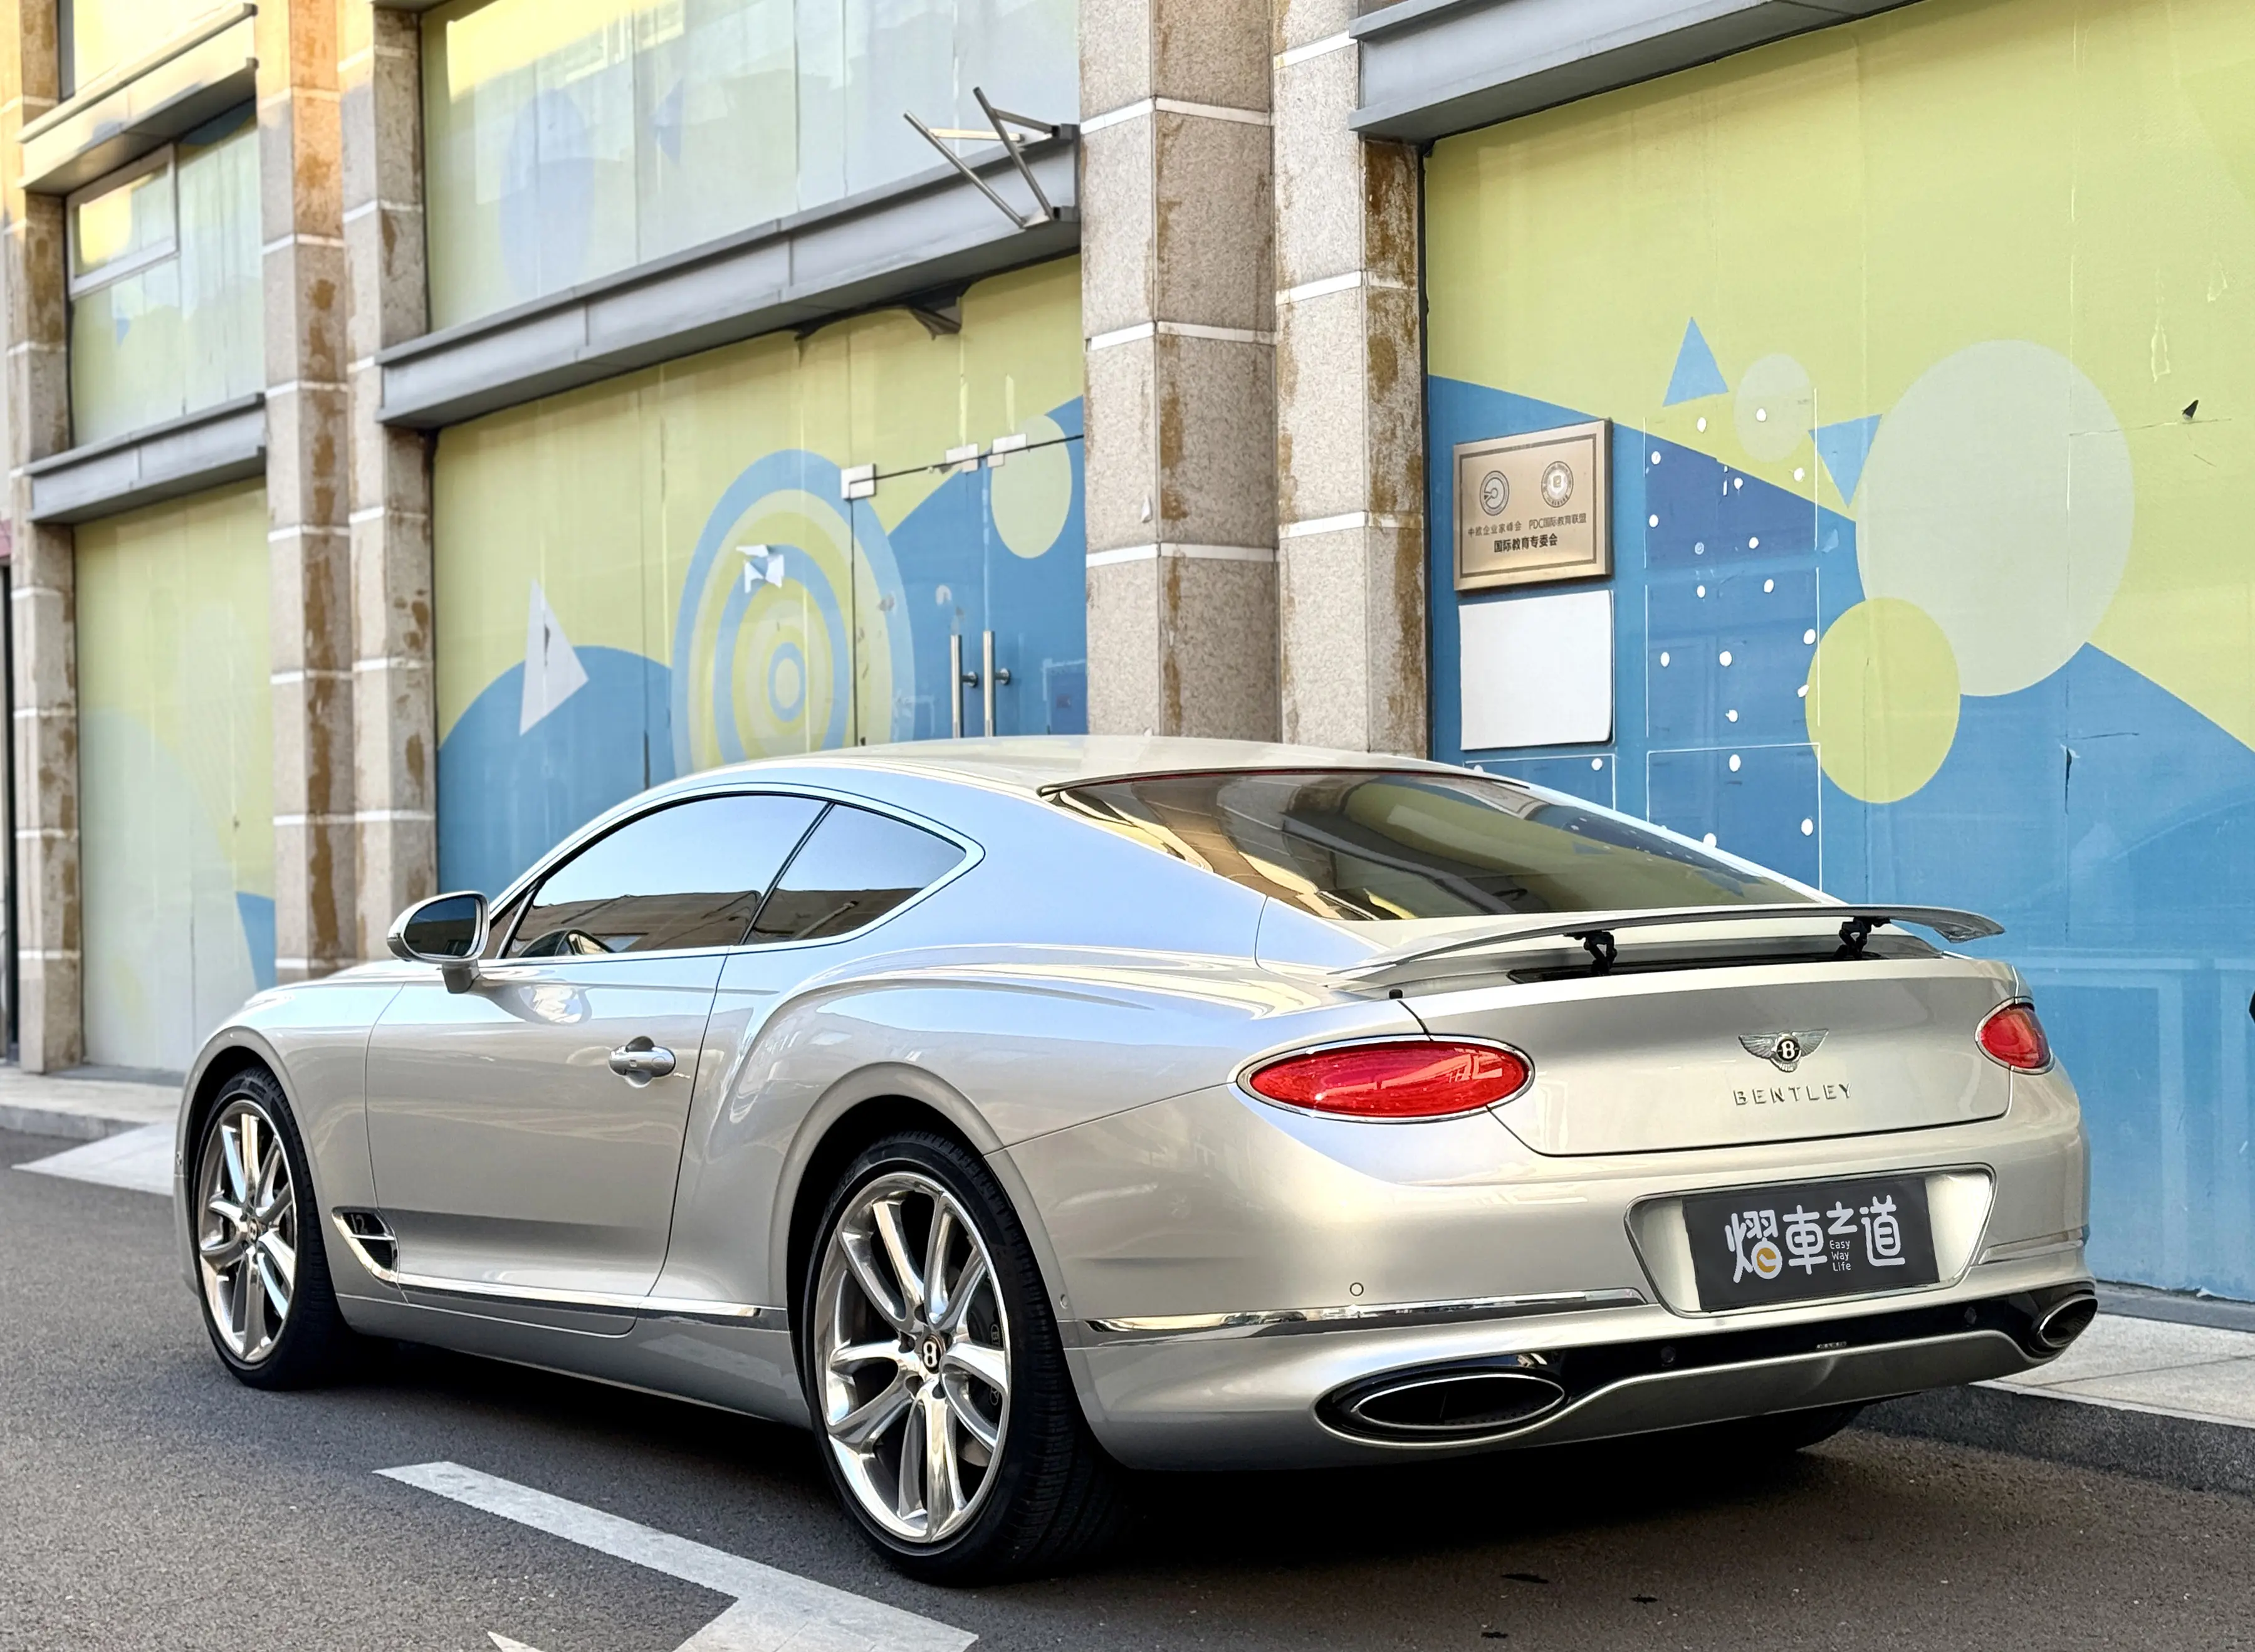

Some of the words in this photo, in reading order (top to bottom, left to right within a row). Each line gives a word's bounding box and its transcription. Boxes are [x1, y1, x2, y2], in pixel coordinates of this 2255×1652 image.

[1494, 533, 1558, 553] 国际教育专委会
[1781, 1040, 1796, 1059] B
[1733, 1082, 1853, 1106] BENTLEY
[1829, 1240, 1850, 1250] Easy
[1831, 1251, 1849, 1261] Way
[1833, 1261, 1851, 1272] Life
